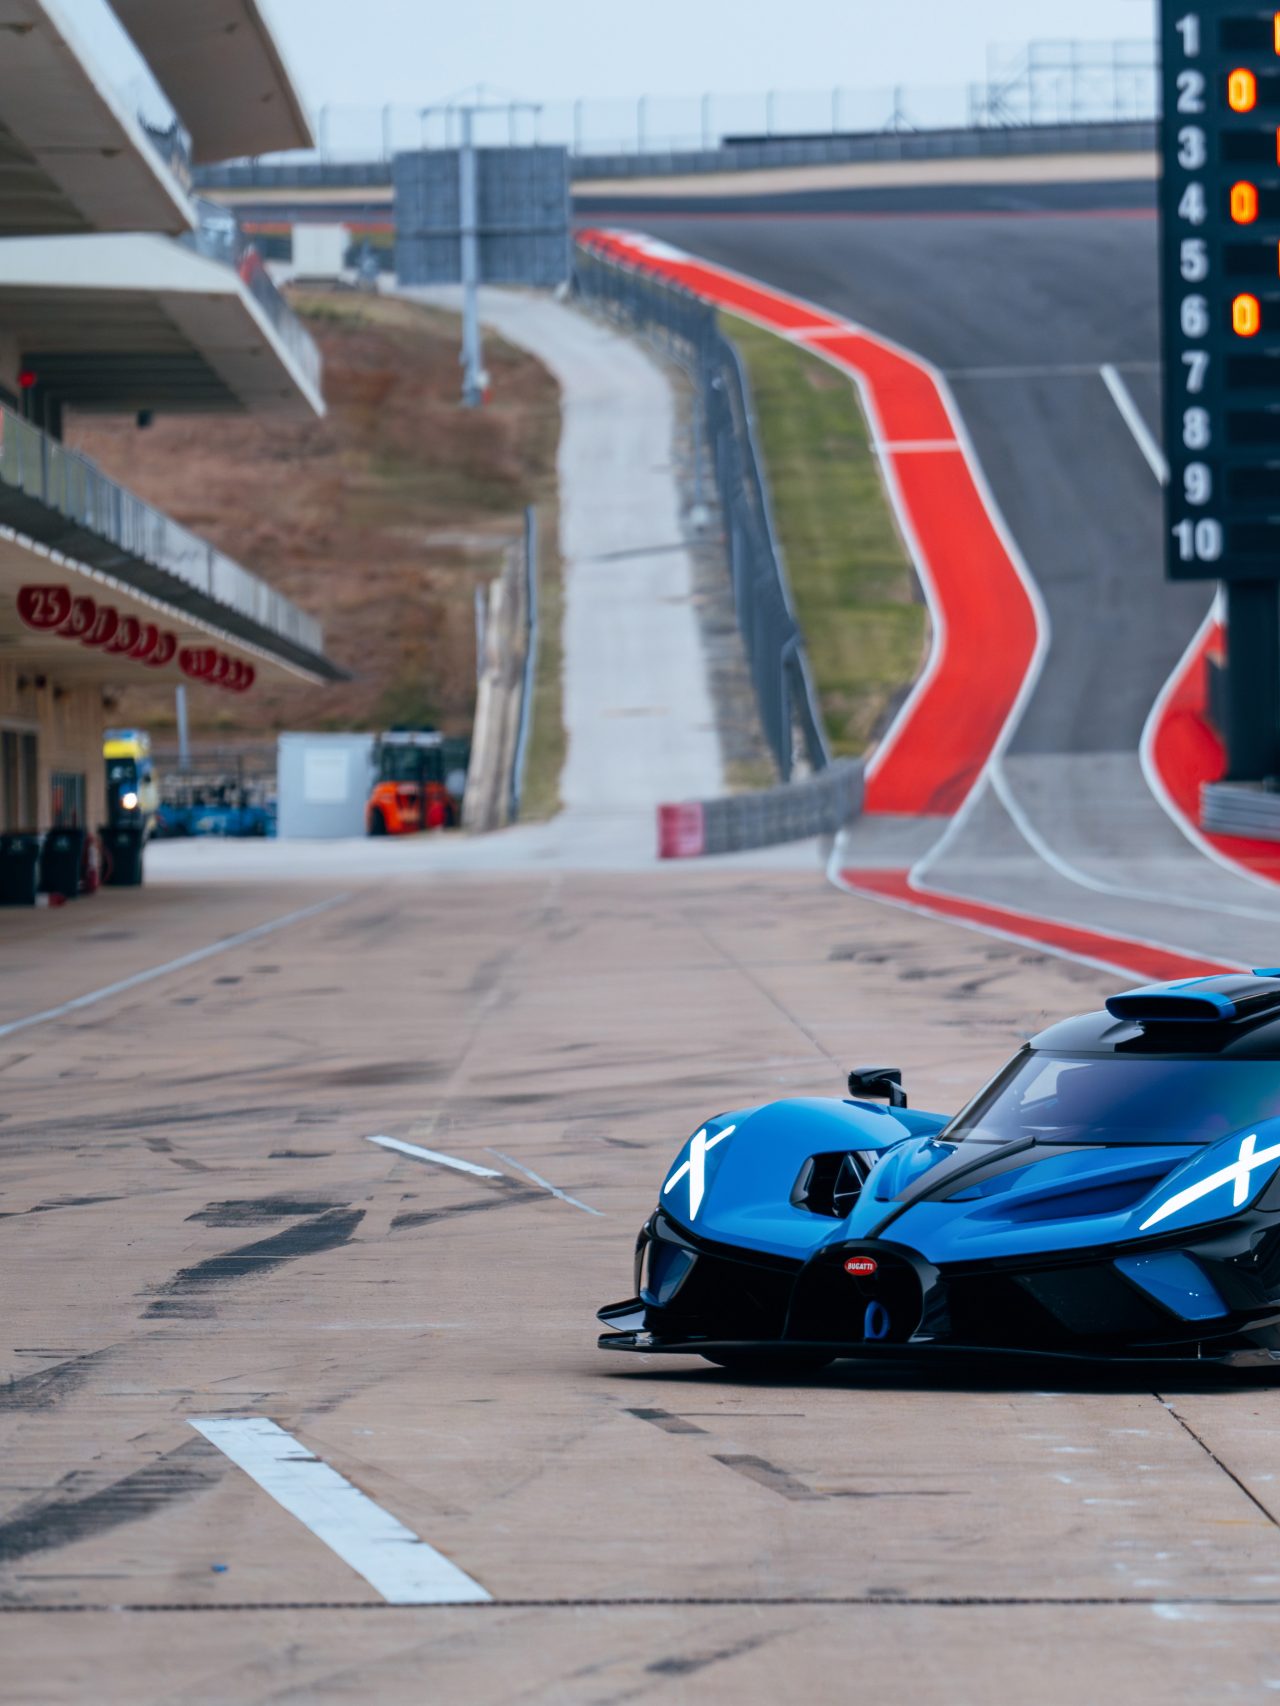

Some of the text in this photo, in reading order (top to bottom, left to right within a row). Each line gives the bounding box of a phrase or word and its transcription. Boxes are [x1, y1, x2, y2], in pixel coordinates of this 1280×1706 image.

[1175, 12, 1199, 57] 1
[1176, 69, 1205, 113] 2
[1177, 125, 1207, 169] 3
[1178, 181, 1207, 225] 4
[1180, 238, 1209, 282] 5
[1180, 294, 1209, 338] 6
[1181, 351, 1210, 393] 7
[1182, 407, 1211, 450] 8
[1183, 463, 1212, 505] 9
[1173, 519, 1222, 562] 10
[30, 591, 60, 621] 25
[847, 1262, 873, 1270] BUGATTI
